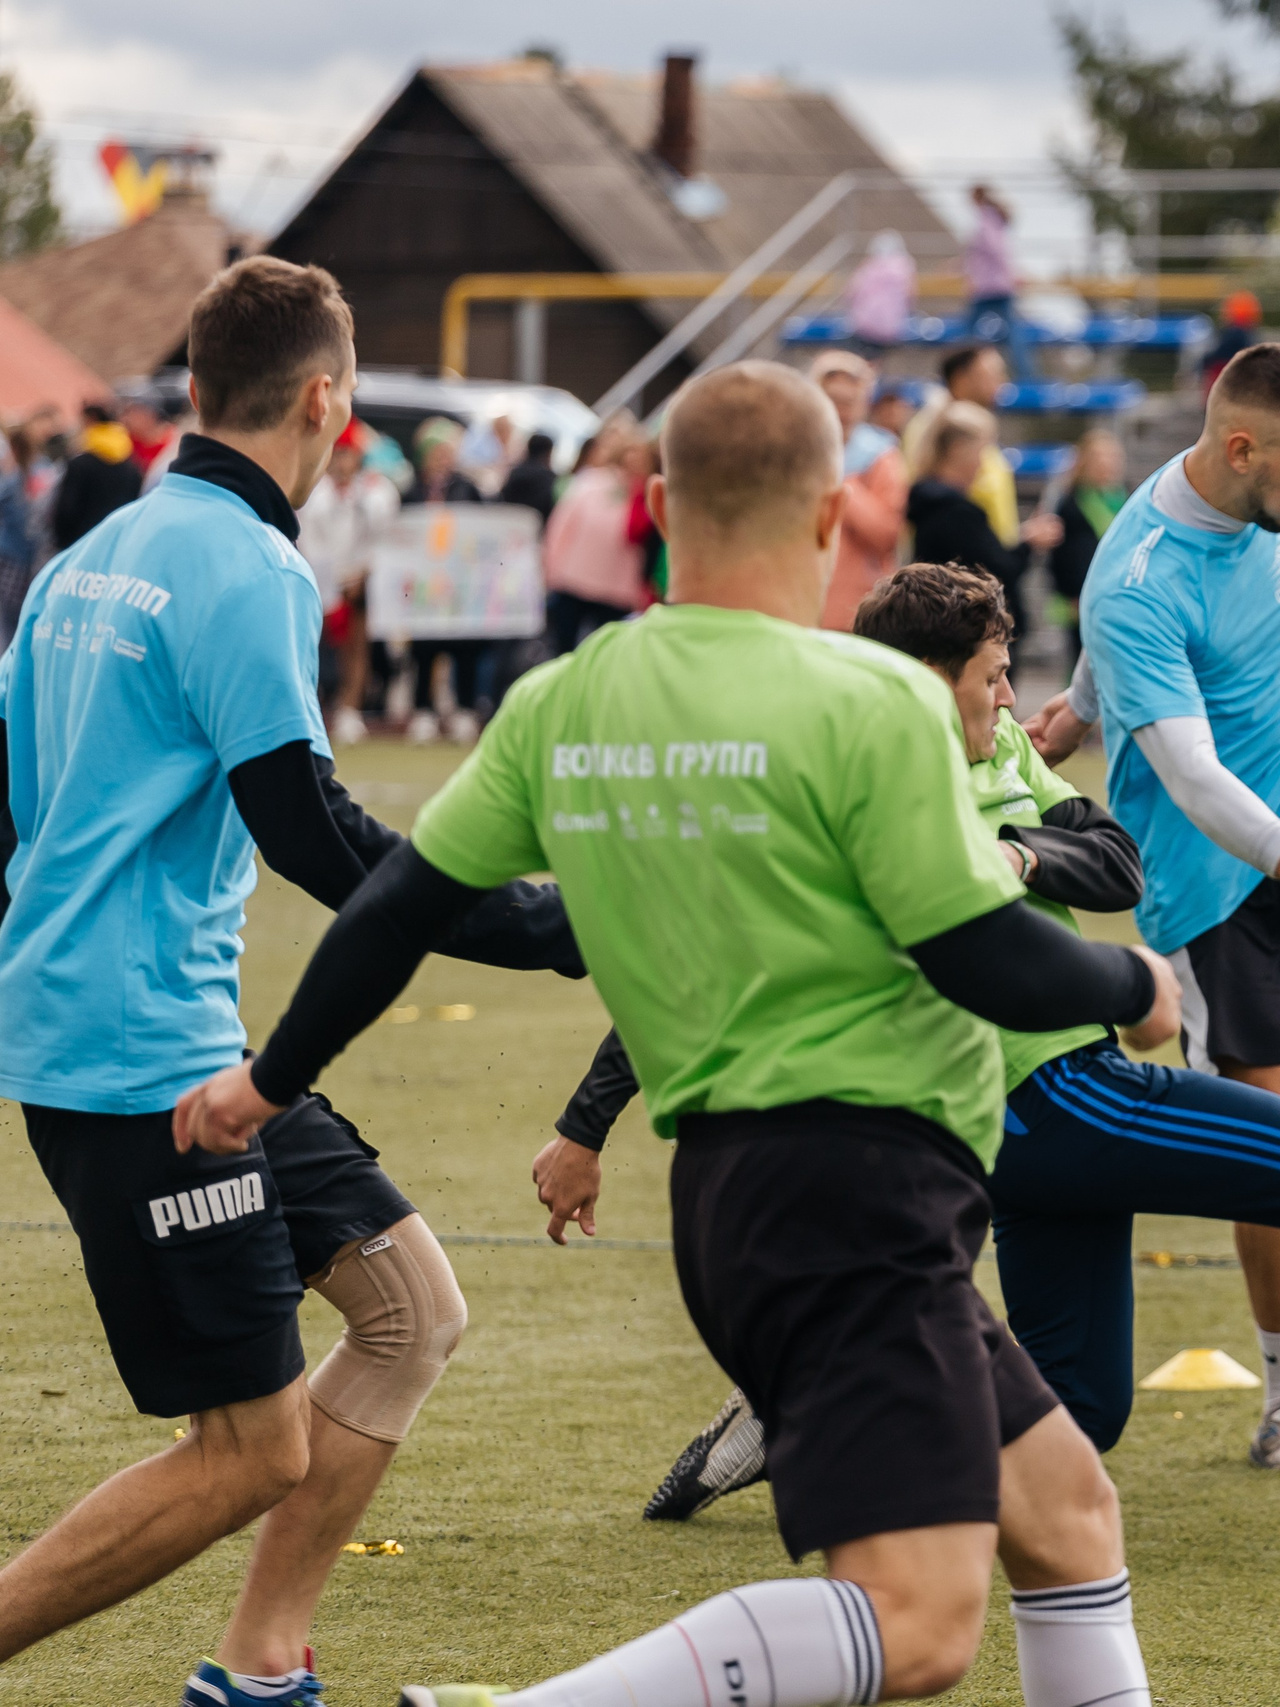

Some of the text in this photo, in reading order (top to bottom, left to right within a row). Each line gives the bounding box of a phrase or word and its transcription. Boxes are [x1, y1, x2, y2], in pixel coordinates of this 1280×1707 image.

[664, 741, 767, 778] ГРУПП
[149, 1171, 265, 1239] PUMA
[364, 1239, 386, 1253] ORTO
